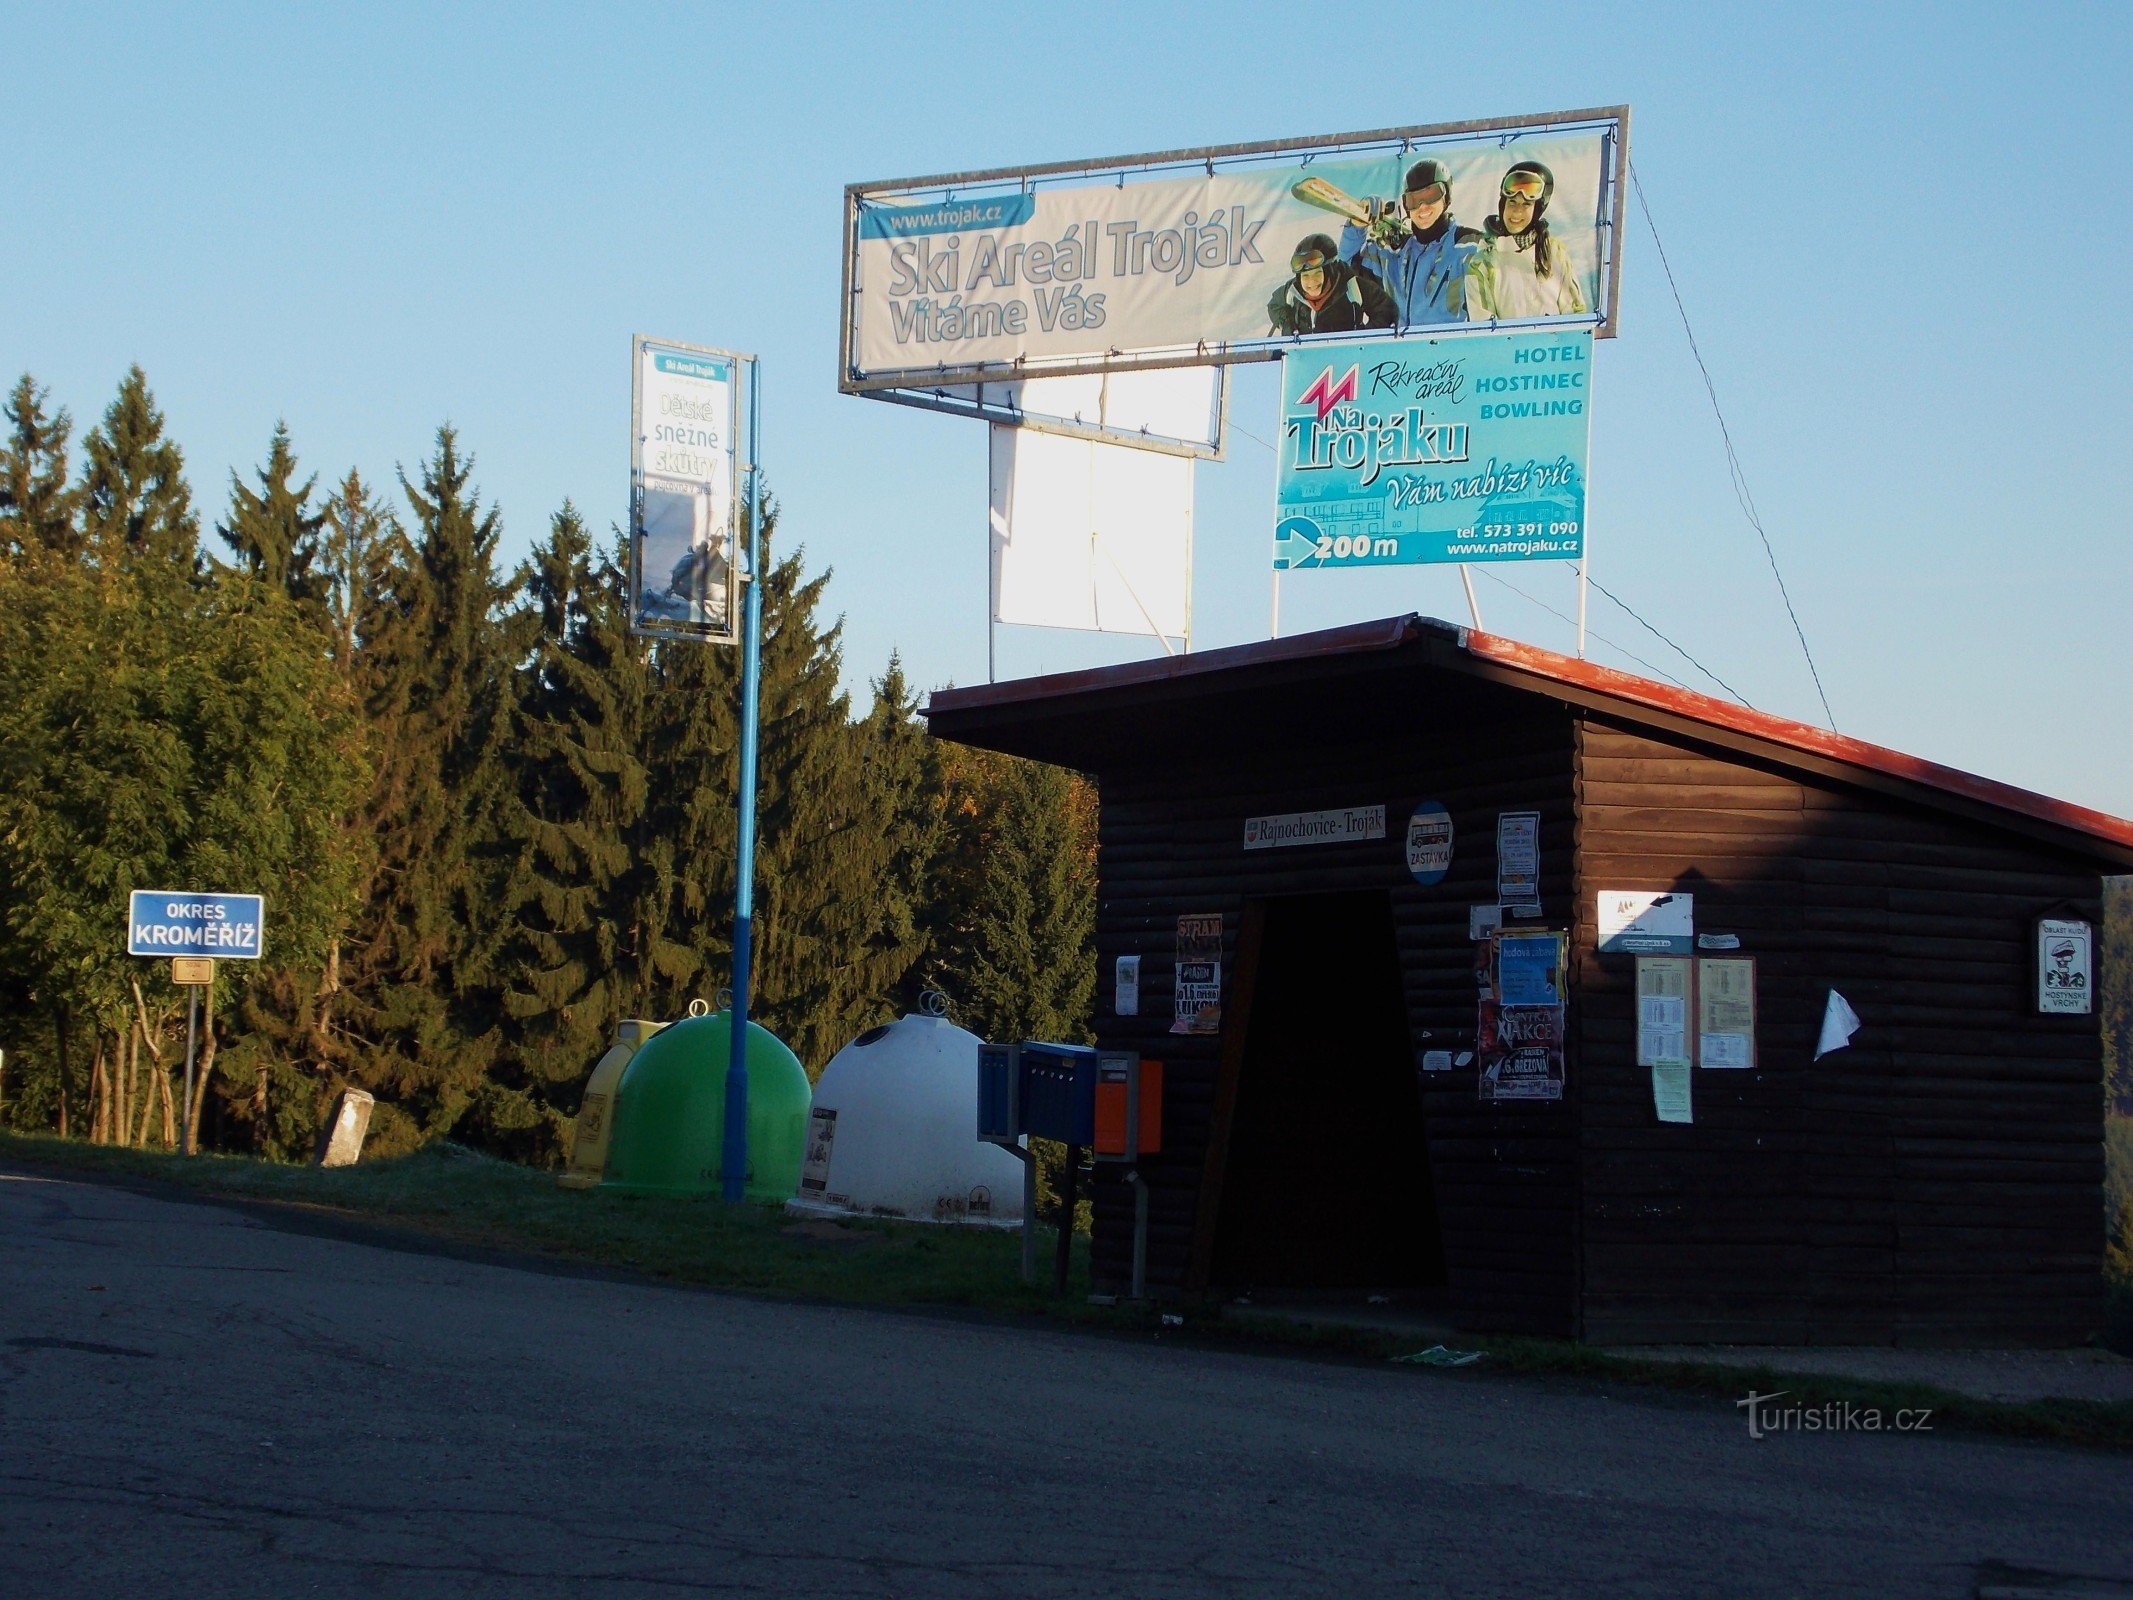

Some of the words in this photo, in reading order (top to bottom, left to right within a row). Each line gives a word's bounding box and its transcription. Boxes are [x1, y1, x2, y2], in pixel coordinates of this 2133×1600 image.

[891, 203, 1002, 230] www.trojak.cz
[889, 235, 960, 296] Ski
[965, 221, 1099, 291] Areál
[1107, 206, 1266, 286] Troják
[890, 294, 1028, 345] Vítáme
[1033, 283, 1107, 333] Vás
[1514, 346, 1586, 364] HOTEL
[1368, 357, 1467, 396] Rekreační
[1415, 374, 1468, 404] areál
[1475, 372, 1584, 394] HOSTINEC
[660, 391, 714, 422] Dětské
[1330, 407, 1362, 430] Na
[1480, 400, 1583, 419] BOWLING
[655, 422, 718, 449] sněžné
[1286, 408, 1469, 486] Trojáku
[655, 445, 718, 483] skůtry
[1387, 474, 1445, 509] Vám
[1451, 456, 1529, 498] nabízí
[1533, 455, 1573, 488] víc
[1457, 526, 1478, 538] tel.
[1483, 524, 1511, 538] 573
[1517, 523, 1543, 536] 391
[1550, 522, 1578, 535] 090
[1314, 536, 1371, 559] 200
[1374, 537, 1398, 556] m
[1447, 538, 1578, 556] www.natrojaku.cz
[1259, 815, 1336, 847] Rajnochovice
[1344, 808, 1383, 838] Troják
[167, 903, 226, 920] OKRES
[135, 922, 256, 947] KROMĚŘÍŽ
[2053, 1000, 2079, 1008] VRCHY
